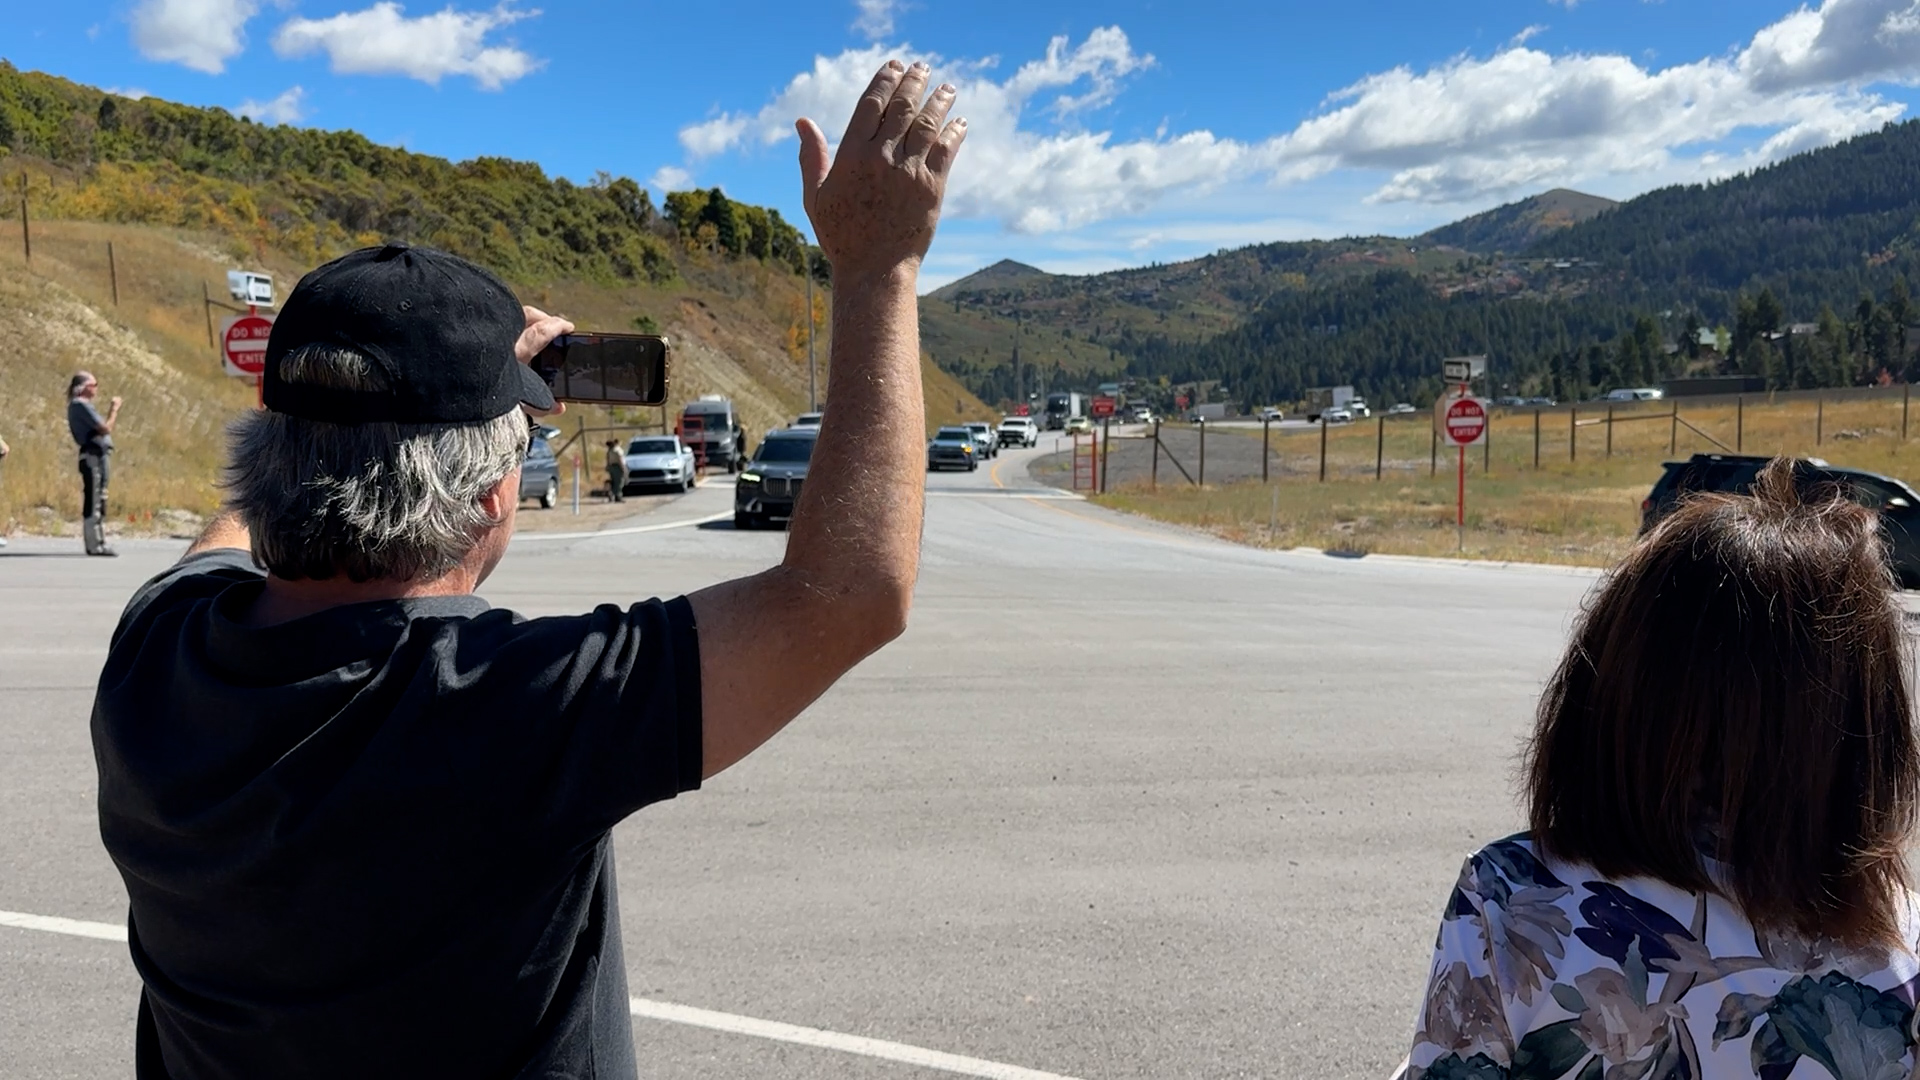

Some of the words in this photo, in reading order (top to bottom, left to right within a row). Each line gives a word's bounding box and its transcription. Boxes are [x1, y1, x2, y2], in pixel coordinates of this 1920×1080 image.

[231, 328, 248, 338] DO
[253, 327, 270, 338] NO
[238, 353, 265, 365] ENTE
[1451, 407, 1462, 416] DO
[1465, 407, 1480, 416] NOT
[1453, 428, 1477, 436] ENTER
